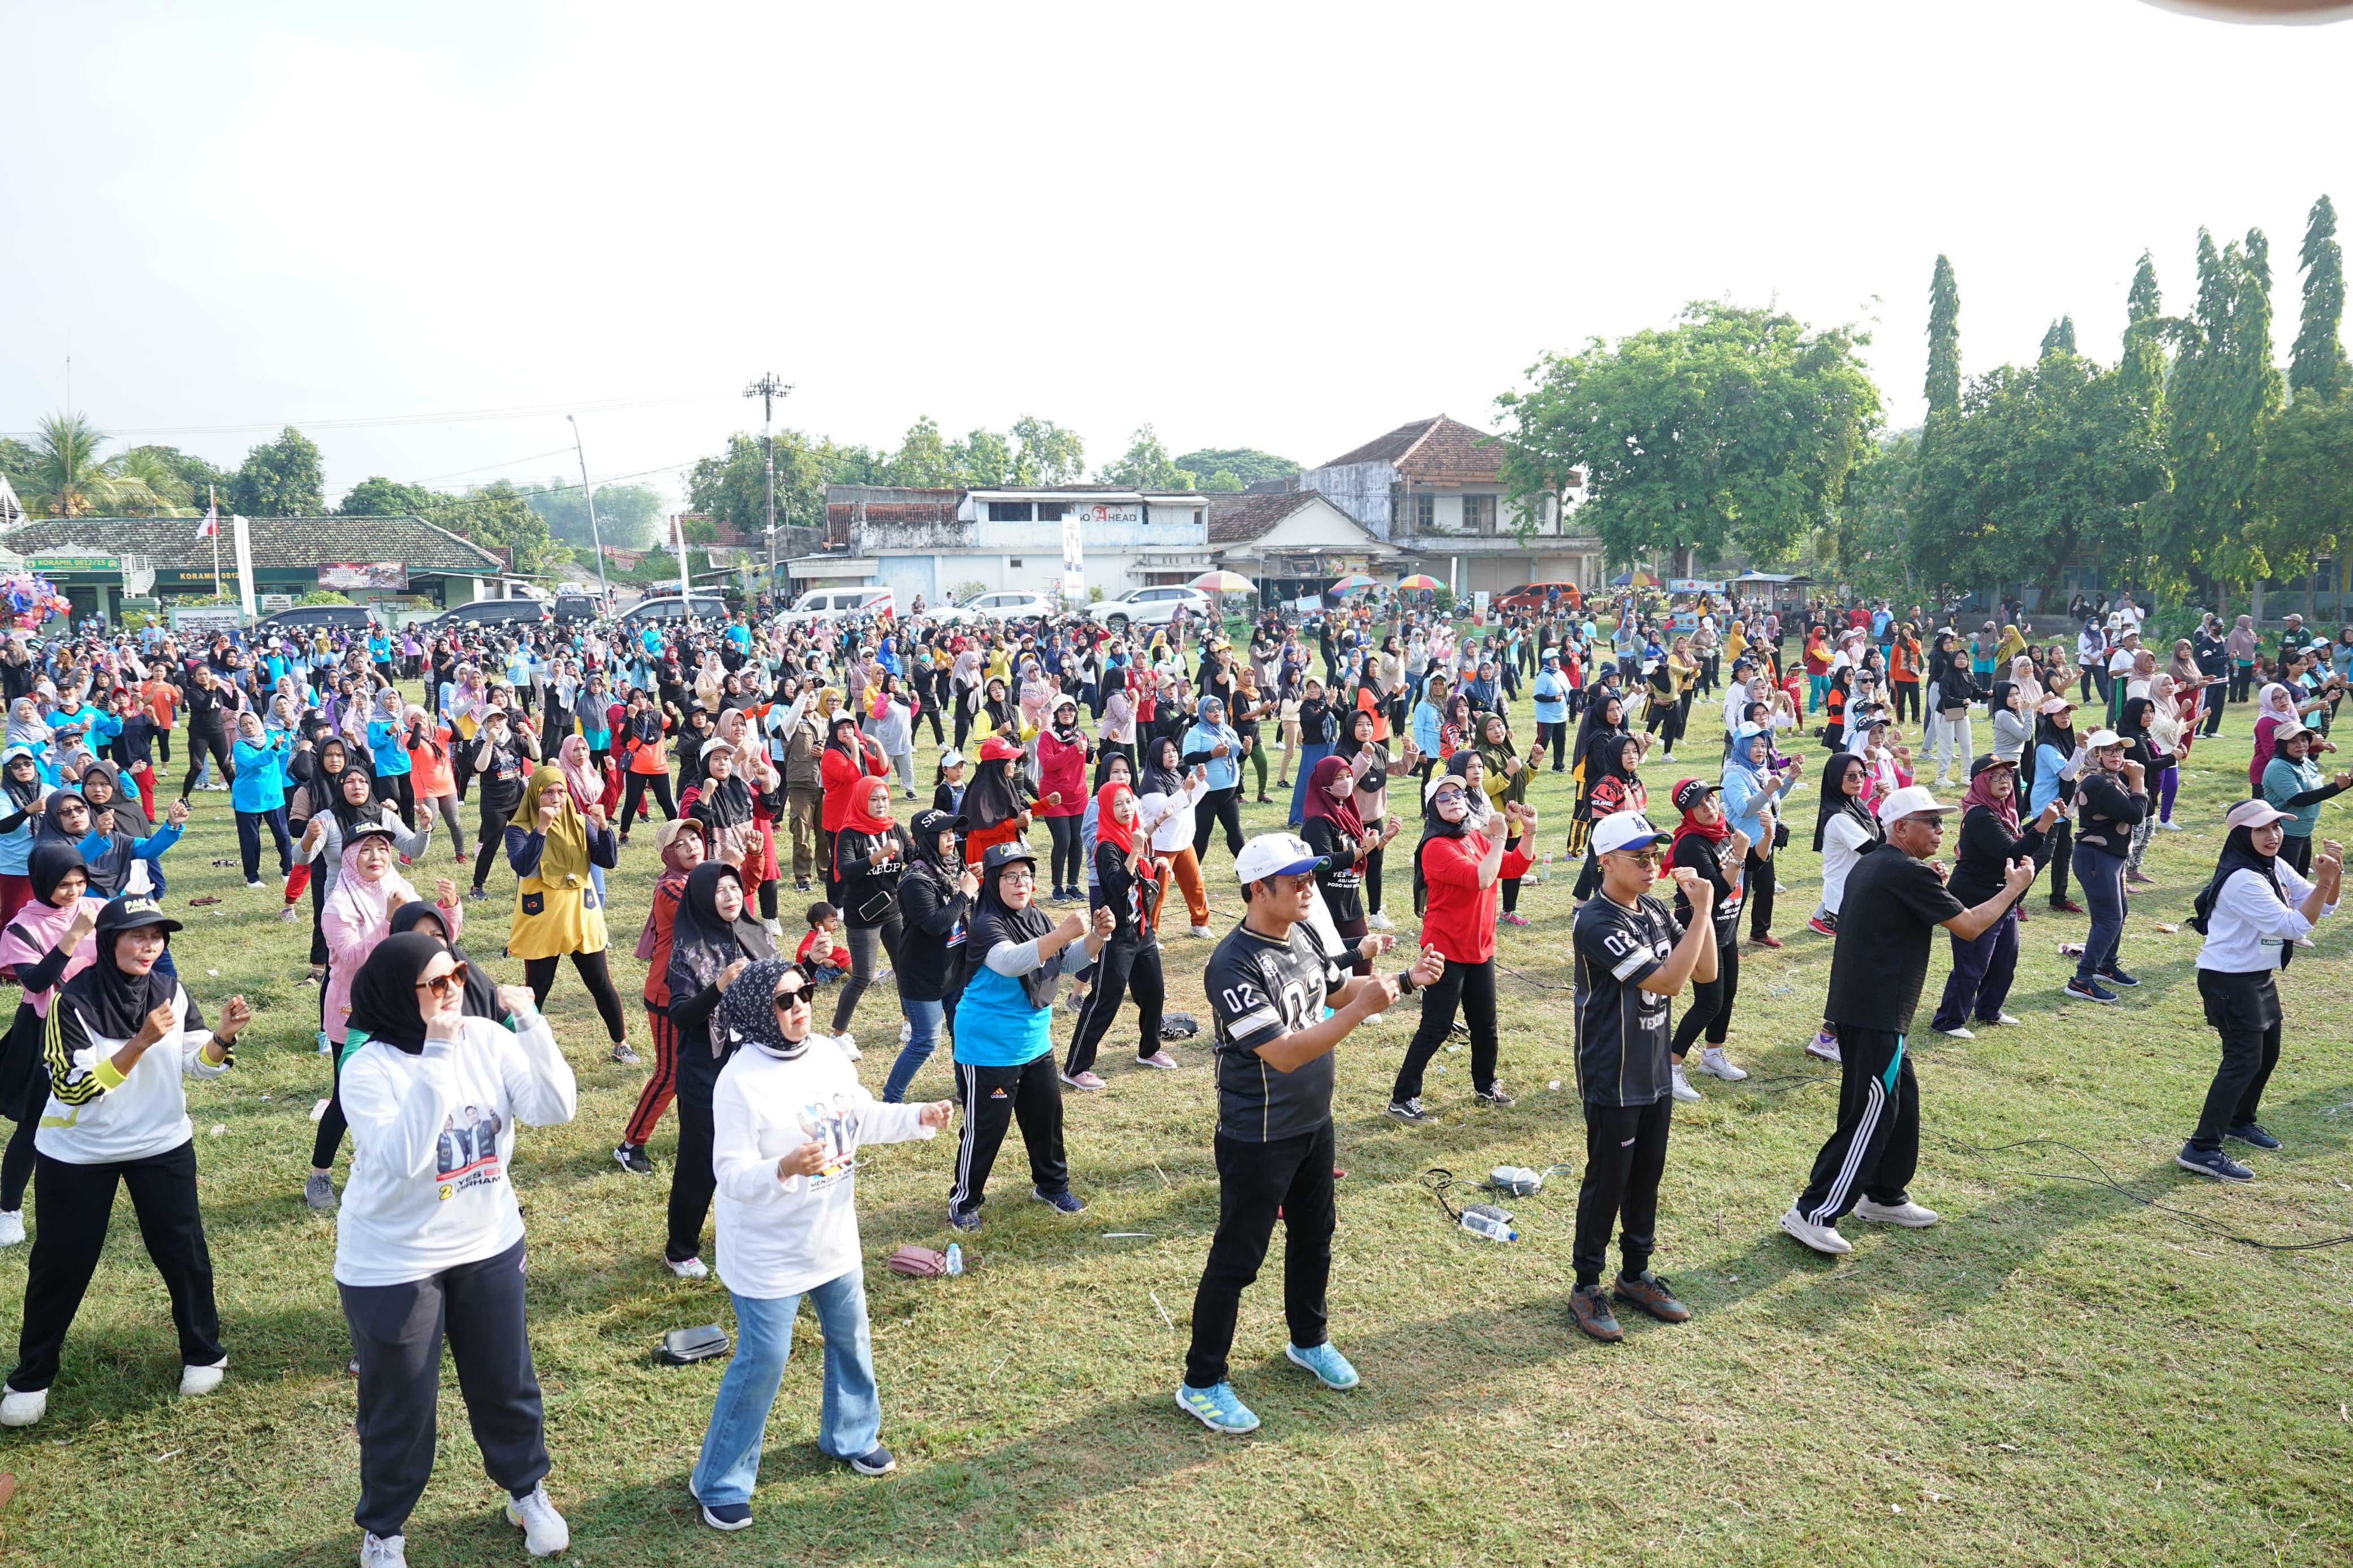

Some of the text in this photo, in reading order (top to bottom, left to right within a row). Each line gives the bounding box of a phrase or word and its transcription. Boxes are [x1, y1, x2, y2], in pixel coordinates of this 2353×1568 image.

[1333, 559, 1344, 572] 76
[124, 897, 147, 910] PAK
[1222, 983, 1260, 1013] 02
[1278, 963, 1327, 1032] 02
[457, 1176, 501, 1194] DIRHAM
[458, 1171, 482, 1186] YES
[811, 1172, 842, 1187] MENJAGA
[439, 1184, 453, 1200] 2
